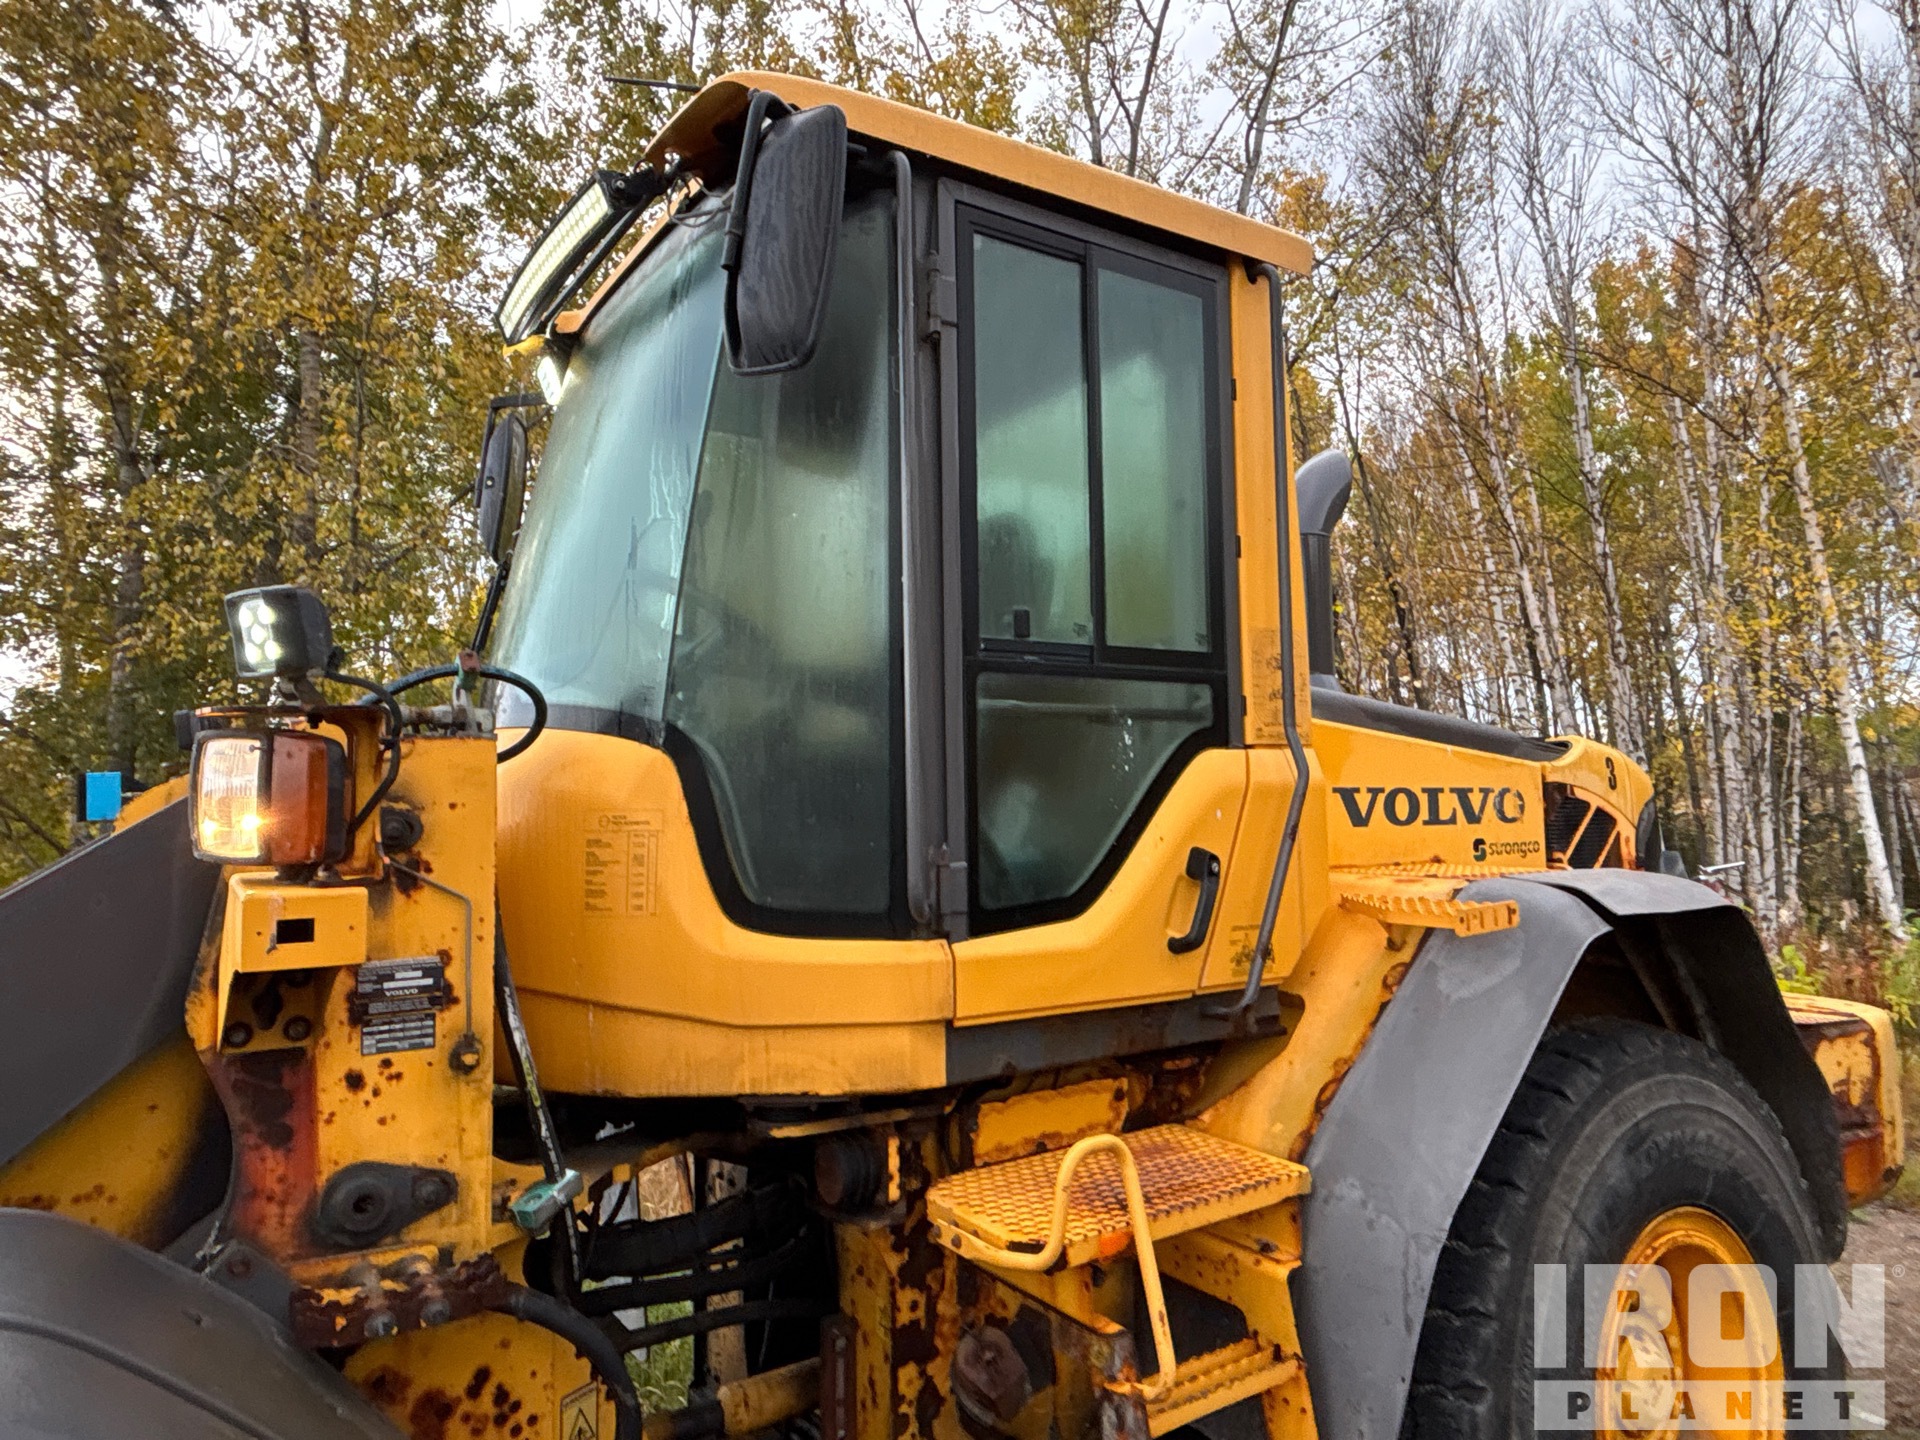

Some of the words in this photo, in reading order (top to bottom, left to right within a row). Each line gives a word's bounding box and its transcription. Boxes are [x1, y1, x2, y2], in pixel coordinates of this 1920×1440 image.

[1605, 757, 1618, 791] 3
[1332, 787, 1525, 828] VOLVO
[384, 988, 418, 997] VOLVO
